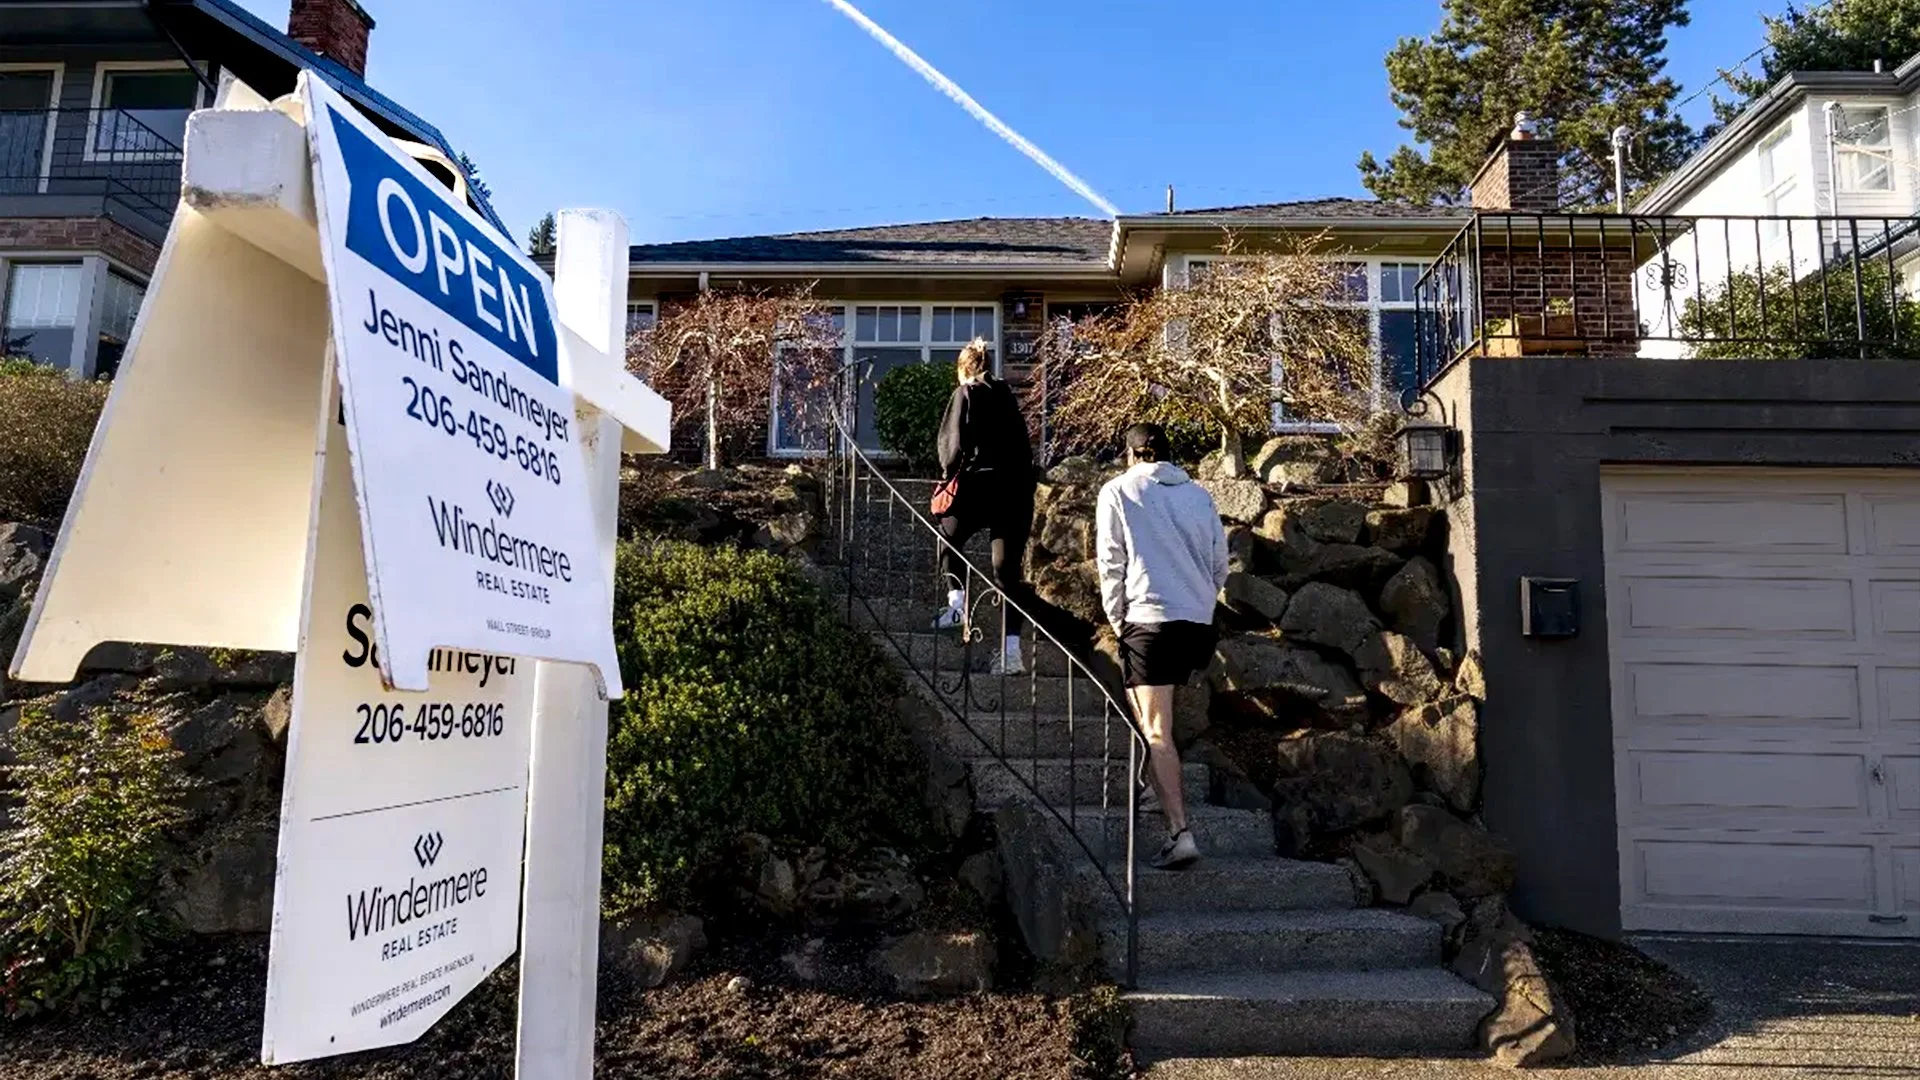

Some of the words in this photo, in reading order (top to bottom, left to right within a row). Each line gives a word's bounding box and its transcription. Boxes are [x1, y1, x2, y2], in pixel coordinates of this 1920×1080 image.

[376, 177, 539, 358] OPEN
[364, 288, 444, 372] Jenni
[449, 339, 569, 443] Sandmeyer
[402, 376, 561, 486] 206-459-6816
[427, 495, 572, 583] Windermere
[476, 570, 508, 596] REAL
[511, 578, 551, 605] ESTATE
[486, 618, 505, 632] WALL
[505, 621, 529, 636] STREET
[530, 626, 551, 639] GROUP
[353, 702, 505, 744] 206-459-6816
[346, 866, 488, 941] Windermere
[381, 938, 413, 962] REAL
[418, 917, 458, 948] ESTATE
[350, 985, 400, 1017] WINDERMERE
[401, 978, 418, 994] REAL
[420, 966, 443, 985] ESTATE
[379, 984, 451, 1029] windermere.com
